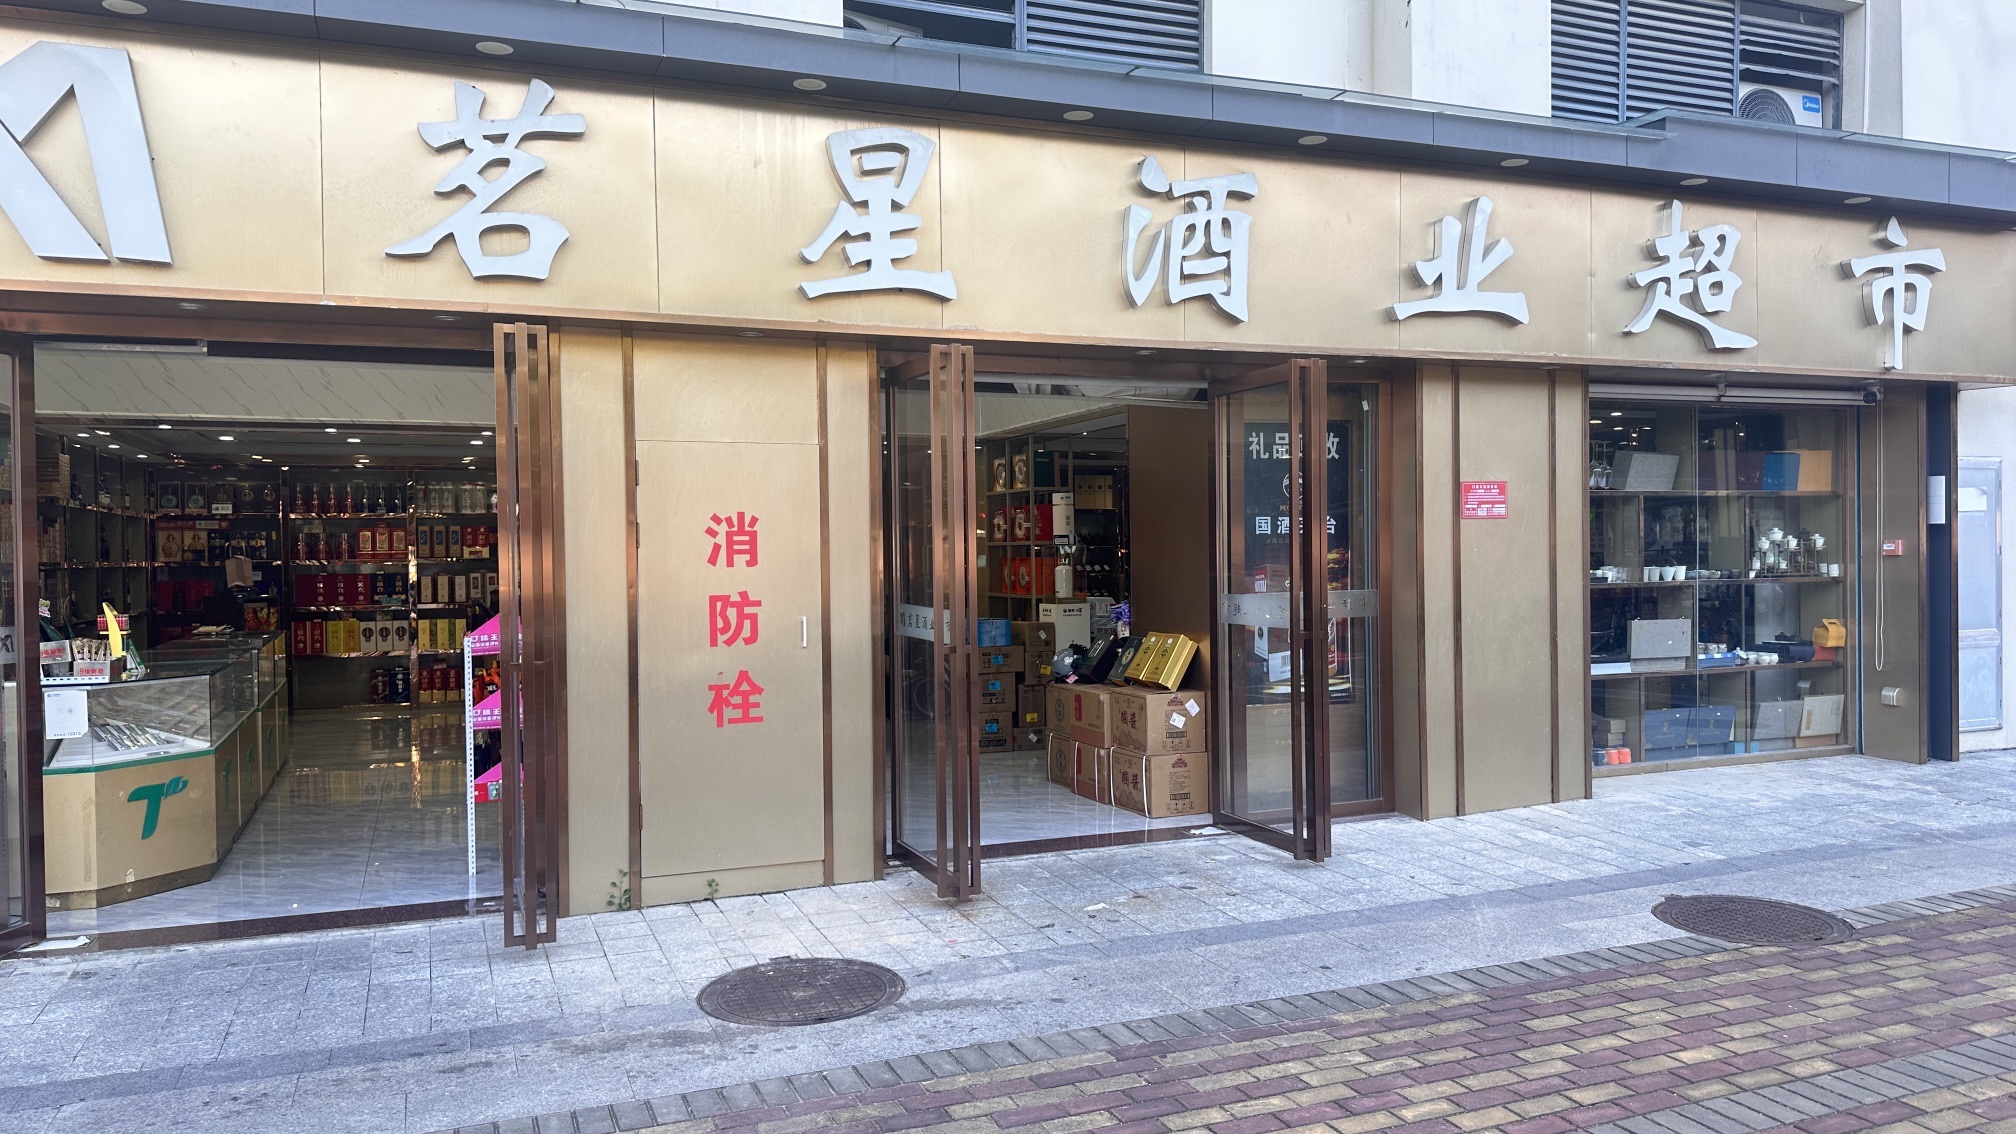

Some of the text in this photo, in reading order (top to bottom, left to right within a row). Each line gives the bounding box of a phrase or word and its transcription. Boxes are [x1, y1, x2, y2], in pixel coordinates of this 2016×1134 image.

[385, 78, 1947, 370] 茗星酒业超市
[1248, 432, 1340, 460] 礼品收
[1255, 516, 1337, 535] 国酒台
[704, 512, 765, 728] 消防栓
